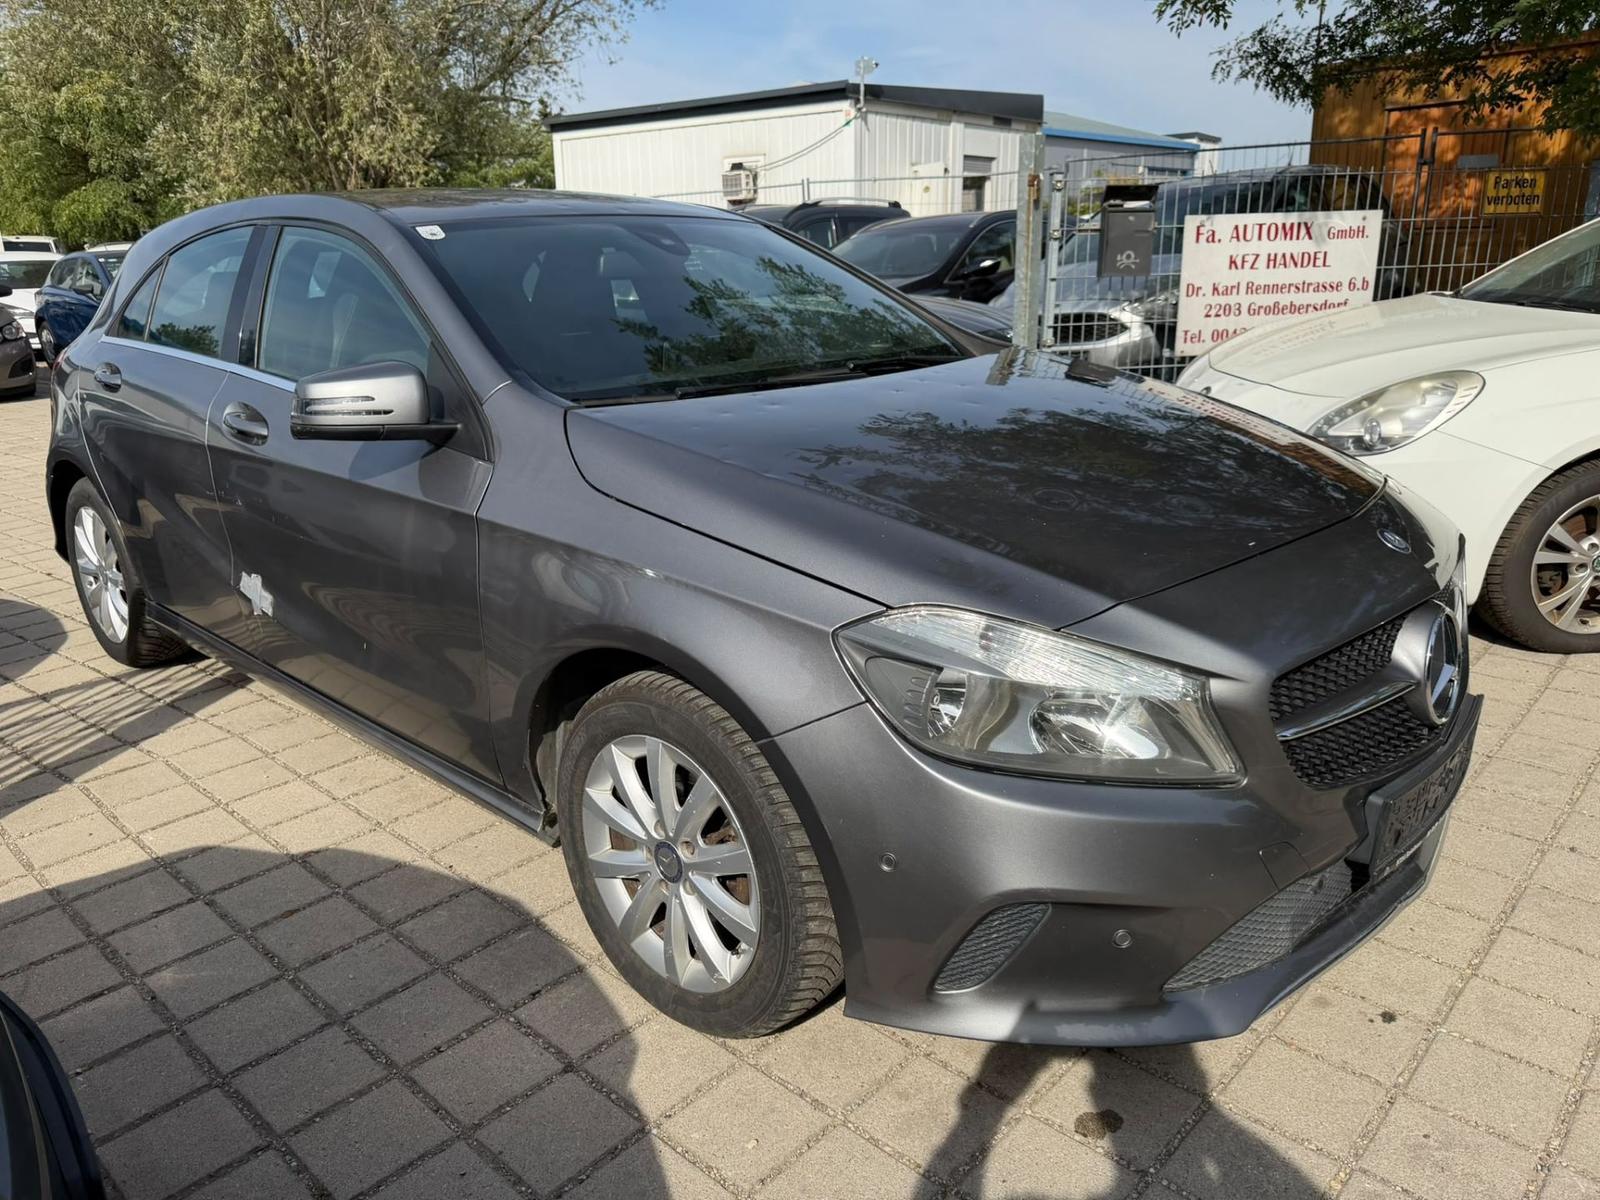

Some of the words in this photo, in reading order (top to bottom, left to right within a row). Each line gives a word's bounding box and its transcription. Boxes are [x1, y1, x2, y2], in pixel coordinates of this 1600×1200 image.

[1493, 175, 1537, 190] Parken
[1486, 193, 1540, 206] verboten
[1195, 224, 1222, 244] Fa.
[1229, 221, 1314, 242] AUTOMIX
[1327, 225, 1369, 240] GmbH.
[1228, 253, 1260, 270] KFZ
[1266, 251, 1332, 269] HANDEL
[1185, 283, 1206, 298] Dr.
[1211, 281, 1241, 296] Karl
[1245, 278, 1343, 295] Rennerstrasse
[1348, 277, 1370, 292] 6.b
[1203, 302, 1242, 318] 2203
[1182, 329, 1206, 345] Tel.
